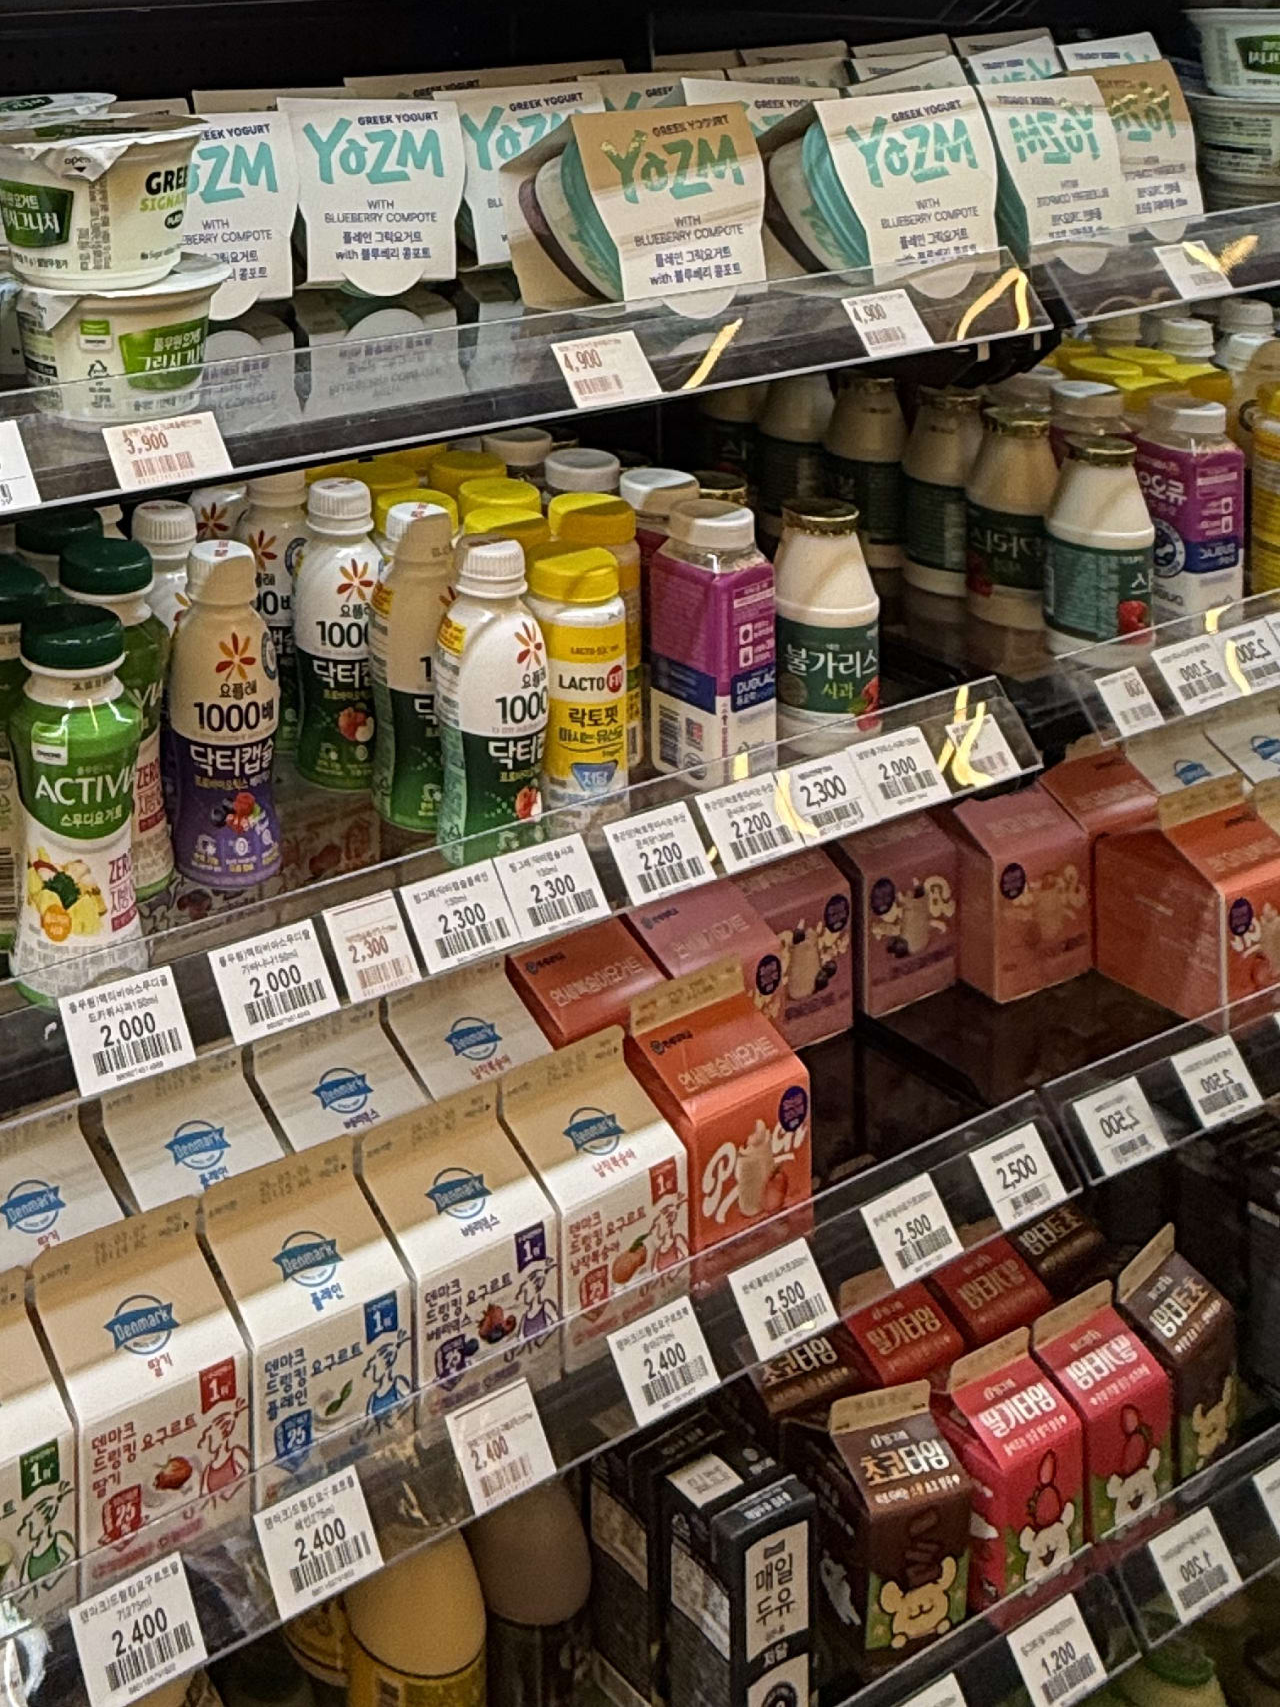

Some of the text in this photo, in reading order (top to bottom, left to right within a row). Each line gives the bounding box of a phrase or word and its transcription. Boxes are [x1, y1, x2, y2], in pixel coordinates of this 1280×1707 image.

[226, 123, 271, 137] YOGURT
[358, 110, 439, 126] GREEK YOGURT
[324, 211, 438, 223] BLUEBERRY COMPOTE
[367, 198, 395, 210] WITH
[881, 206, 980, 230] BLUEBERRY COMPOTE
[221, 229, 272, 243] COMPOTE
[634, 224, 744, 247] BLUEBERRY COMPOTE
[674, 215, 702, 227] WITH
[564, 349, 602, 372] 4,900
[123, 432, 169, 455] 3,900
[784, 642, 880, 677] 불가리스
[558, 674, 605, 691] LACTO
[568, 704, 618, 728] 락토핏
[878, 755, 918, 781] 2,000
[799, 775, 848, 809] 2,300
[730, 811, 772, 839] 2,200
[639, 842, 683, 870] 2,200
[530, 874, 576, 903] 2,300
[438, 903, 486, 935] 2,300
[347, 937, 390, 964] 2,300
[249, 964, 302, 998] 2,000
[99, 1012, 156, 1047] 2,000
[996, 1154, 1038, 1190] 2,500
[6, 1189, 59, 1222] Denmark
[895, 1215, 932, 1246] 2,500
[281, 1242, 337, 1272] Denmark
[425, 1278, 461, 1304] 덴마크
[765, 1282, 806, 1315] 2,500
[113, 1306, 173, 1339] Denmark
[264, 1347, 306, 1373] 덴마크
[643, 1342, 686, 1379] 2,400
[264, 1363, 308, 1395] 드링킹
[977, 1383, 1058, 1438] 딸기타임
[91, 1412, 197, 1454] 덴마크 요구르트
[92, 1438, 138, 1477] 드링킹
[859, 1440, 950, 1485] 초코타임
[294, 1518, 346, 1561] 2,400
[755, 1553, 793, 1591] 매일
[111, 1607, 168, 1658] 2,400
